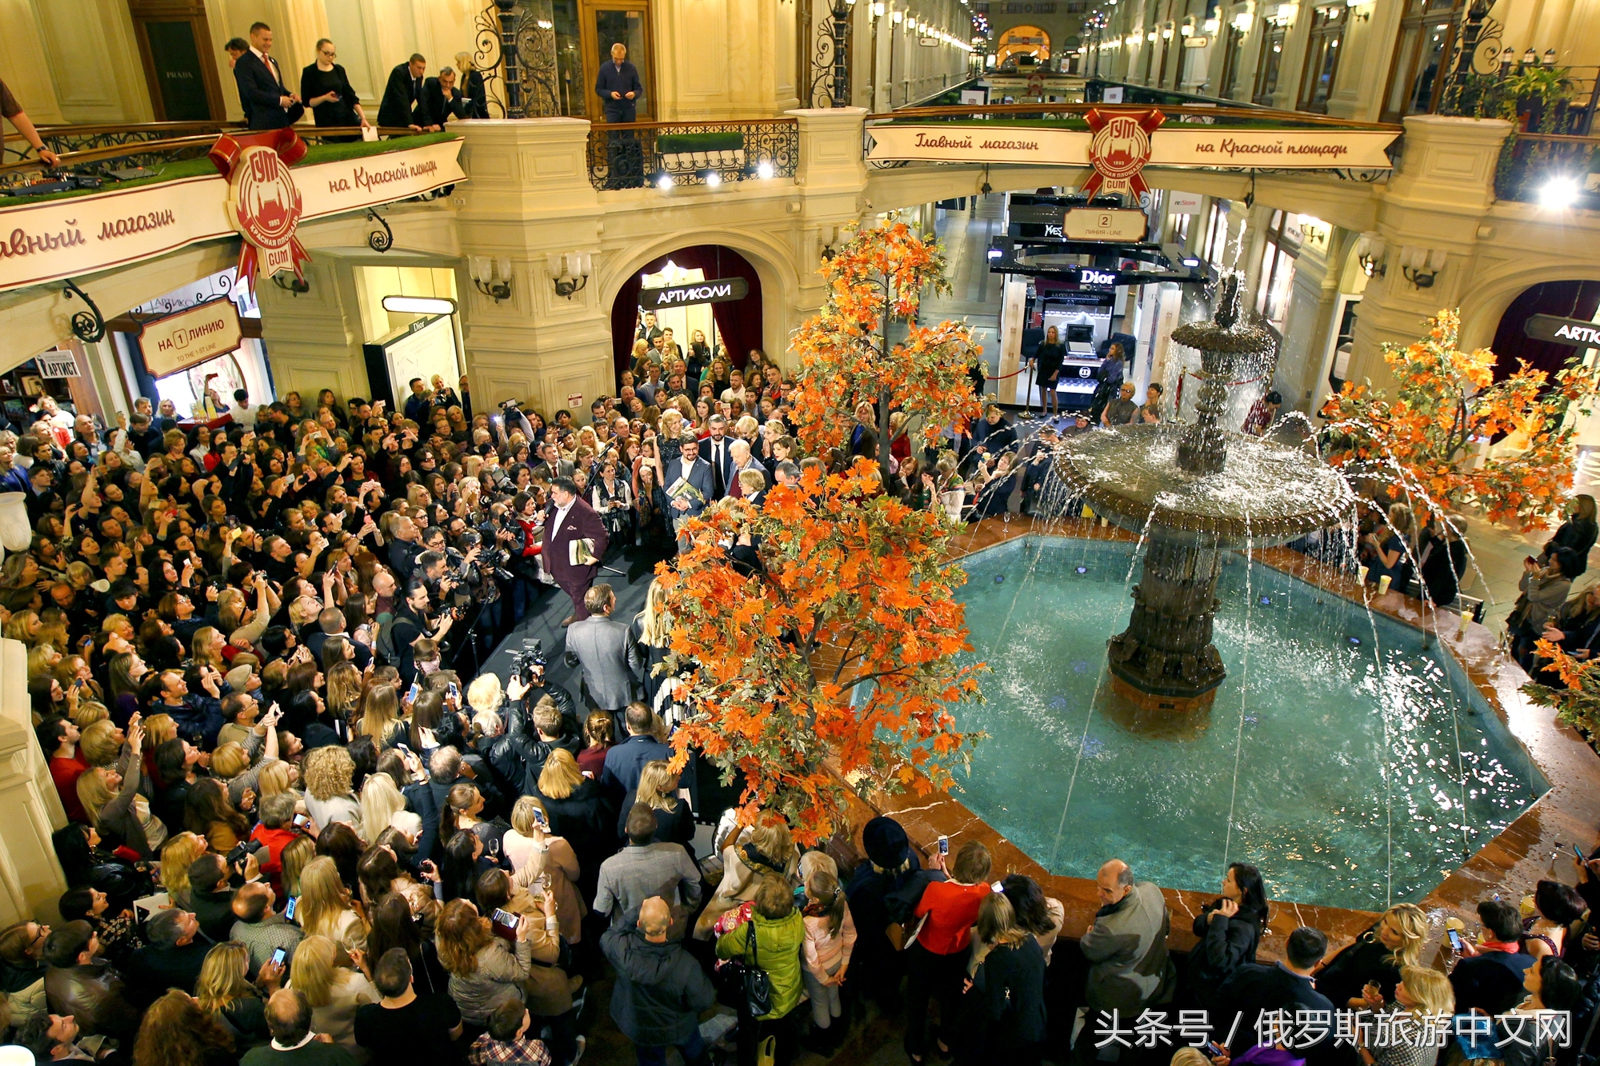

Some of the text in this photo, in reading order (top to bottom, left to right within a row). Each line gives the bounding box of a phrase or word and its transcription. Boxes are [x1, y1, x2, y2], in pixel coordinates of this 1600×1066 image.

[166, 71, 194, 79] PRADA
[1109, 119, 1136, 139] ГУМ
[915, 133, 1039, 150] Главный магазин
[1195, 138, 1348, 158] на Красной площади
[249, 150, 279, 183] ГУМ
[1095, 160, 1143, 178] КРАСНАЯ ПЛОЩАДЬ
[328, 179, 351, 194] на
[353, 162, 408, 193] Красной
[1106, 180, 1126, 189] GUM
[97, 208, 176, 241] магазин
[249, 214, 300, 247] КРАСНАЯ ПЛОЩАДЬ
[1101, 216, 1109, 226] 2
[268, 248, 289, 267] GUM
[1080, 270, 1115, 285] Dior
[657, 283, 732, 305] АРТИКОЛИ
[158, 338, 174, 352] НА
[189, 319, 225, 341] ЛИНИЮ
[413, 320, 425, 332] Dior
[176, 354, 185, 363] TO
[185, 351, 196, 360] THE
[206, 343, 217, 352] LINE
[48, 361, 78, 377] АРТИСТ
